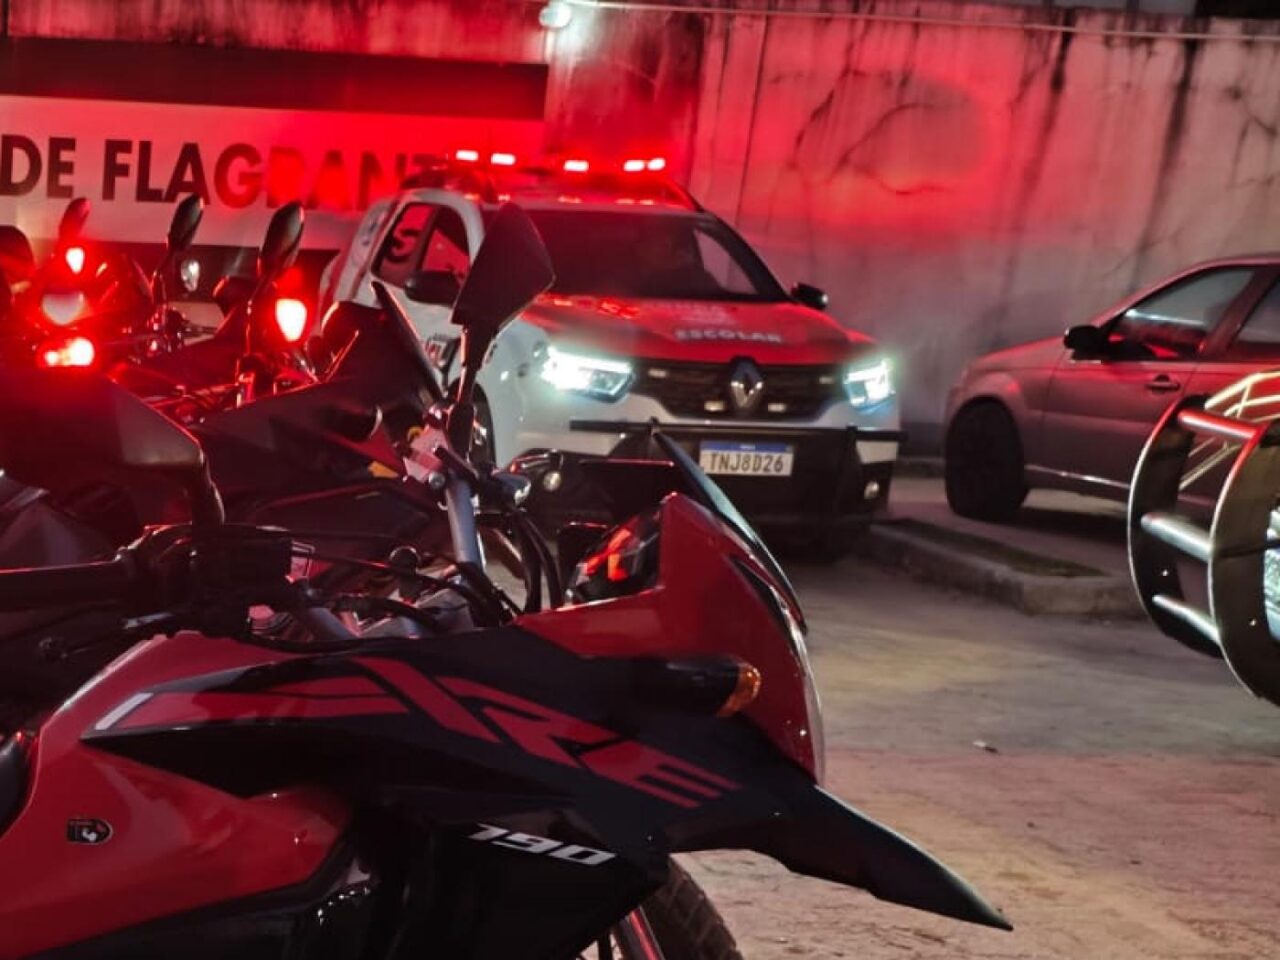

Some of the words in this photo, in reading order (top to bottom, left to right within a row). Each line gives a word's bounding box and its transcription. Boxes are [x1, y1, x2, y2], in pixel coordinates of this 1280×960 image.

[0, 133, 76, 200] DE
[675, 328, 782, 344] ESCOLAR
[710, 452, 784, 473] TNJ8D26
[467, 822, 618, 866] 190
